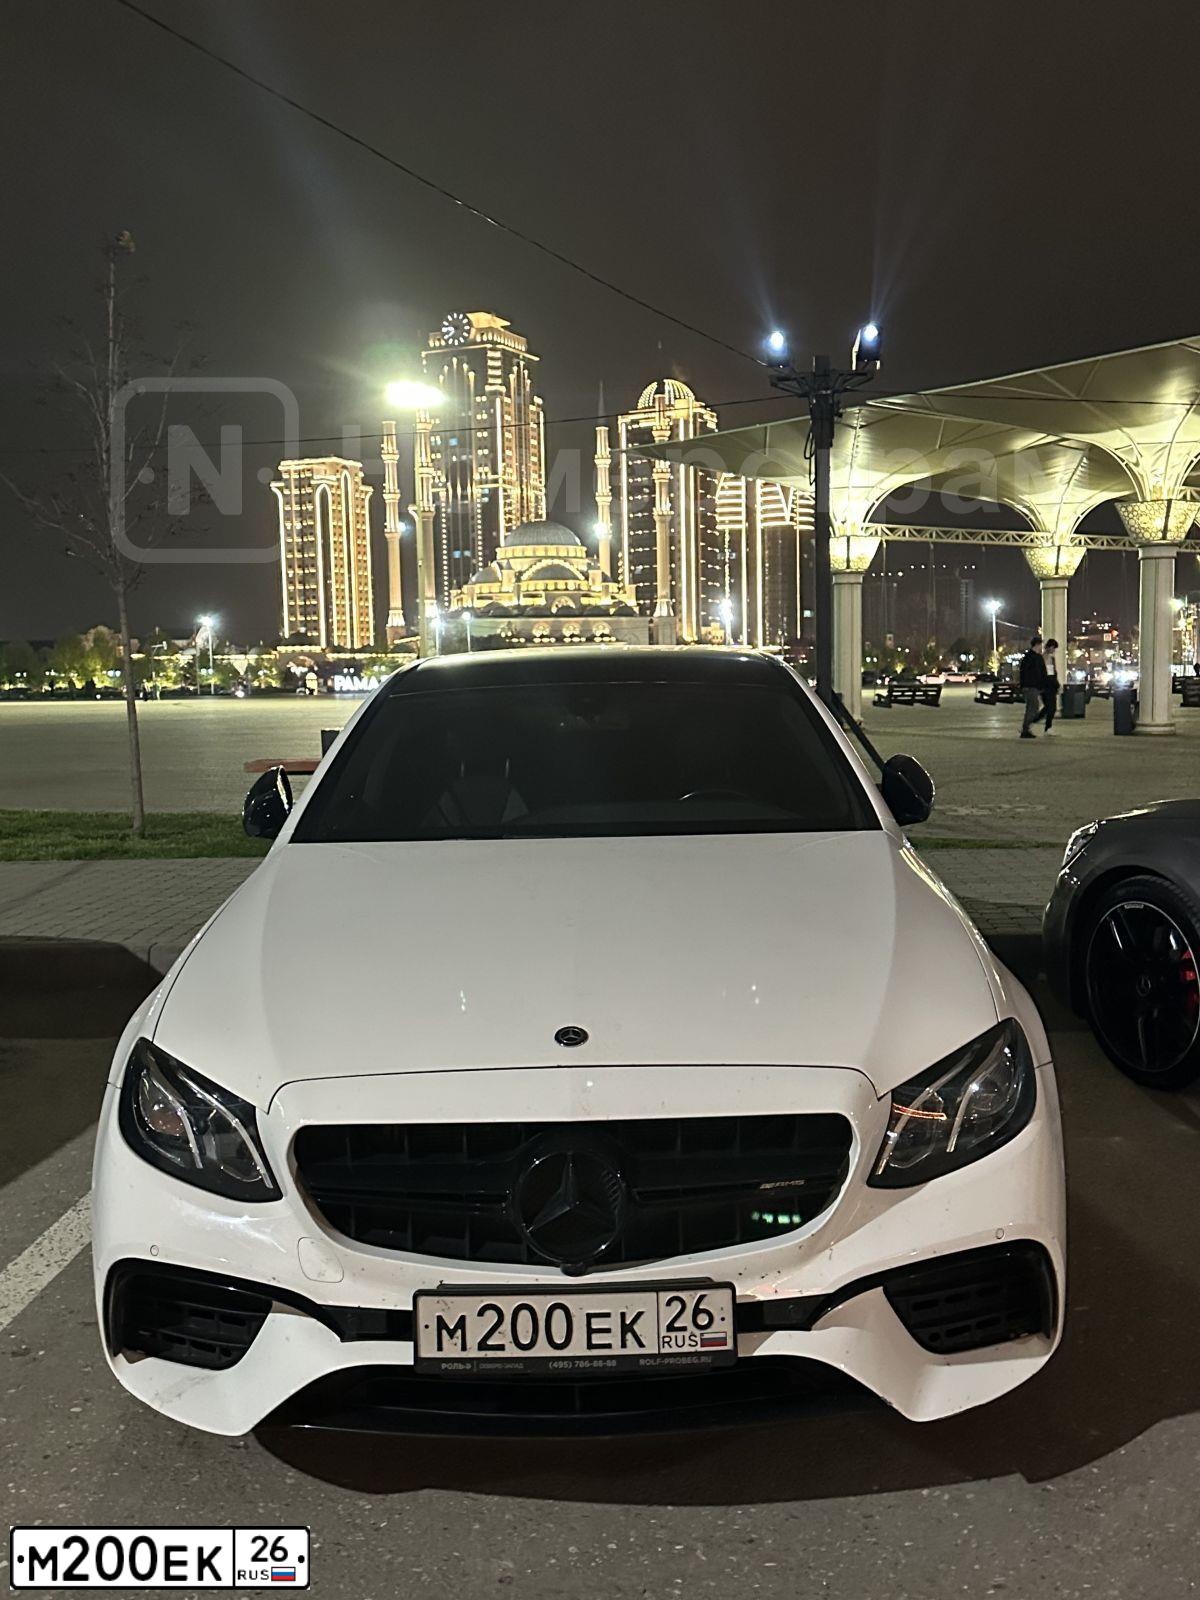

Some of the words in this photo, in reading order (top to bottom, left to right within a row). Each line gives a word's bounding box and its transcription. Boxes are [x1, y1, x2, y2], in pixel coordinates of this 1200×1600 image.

[435, 1302, 647, 1352] М200ЕК
[665, 1294, 714, 1332] 26
[661, 1333, 698, 1350] RUS
